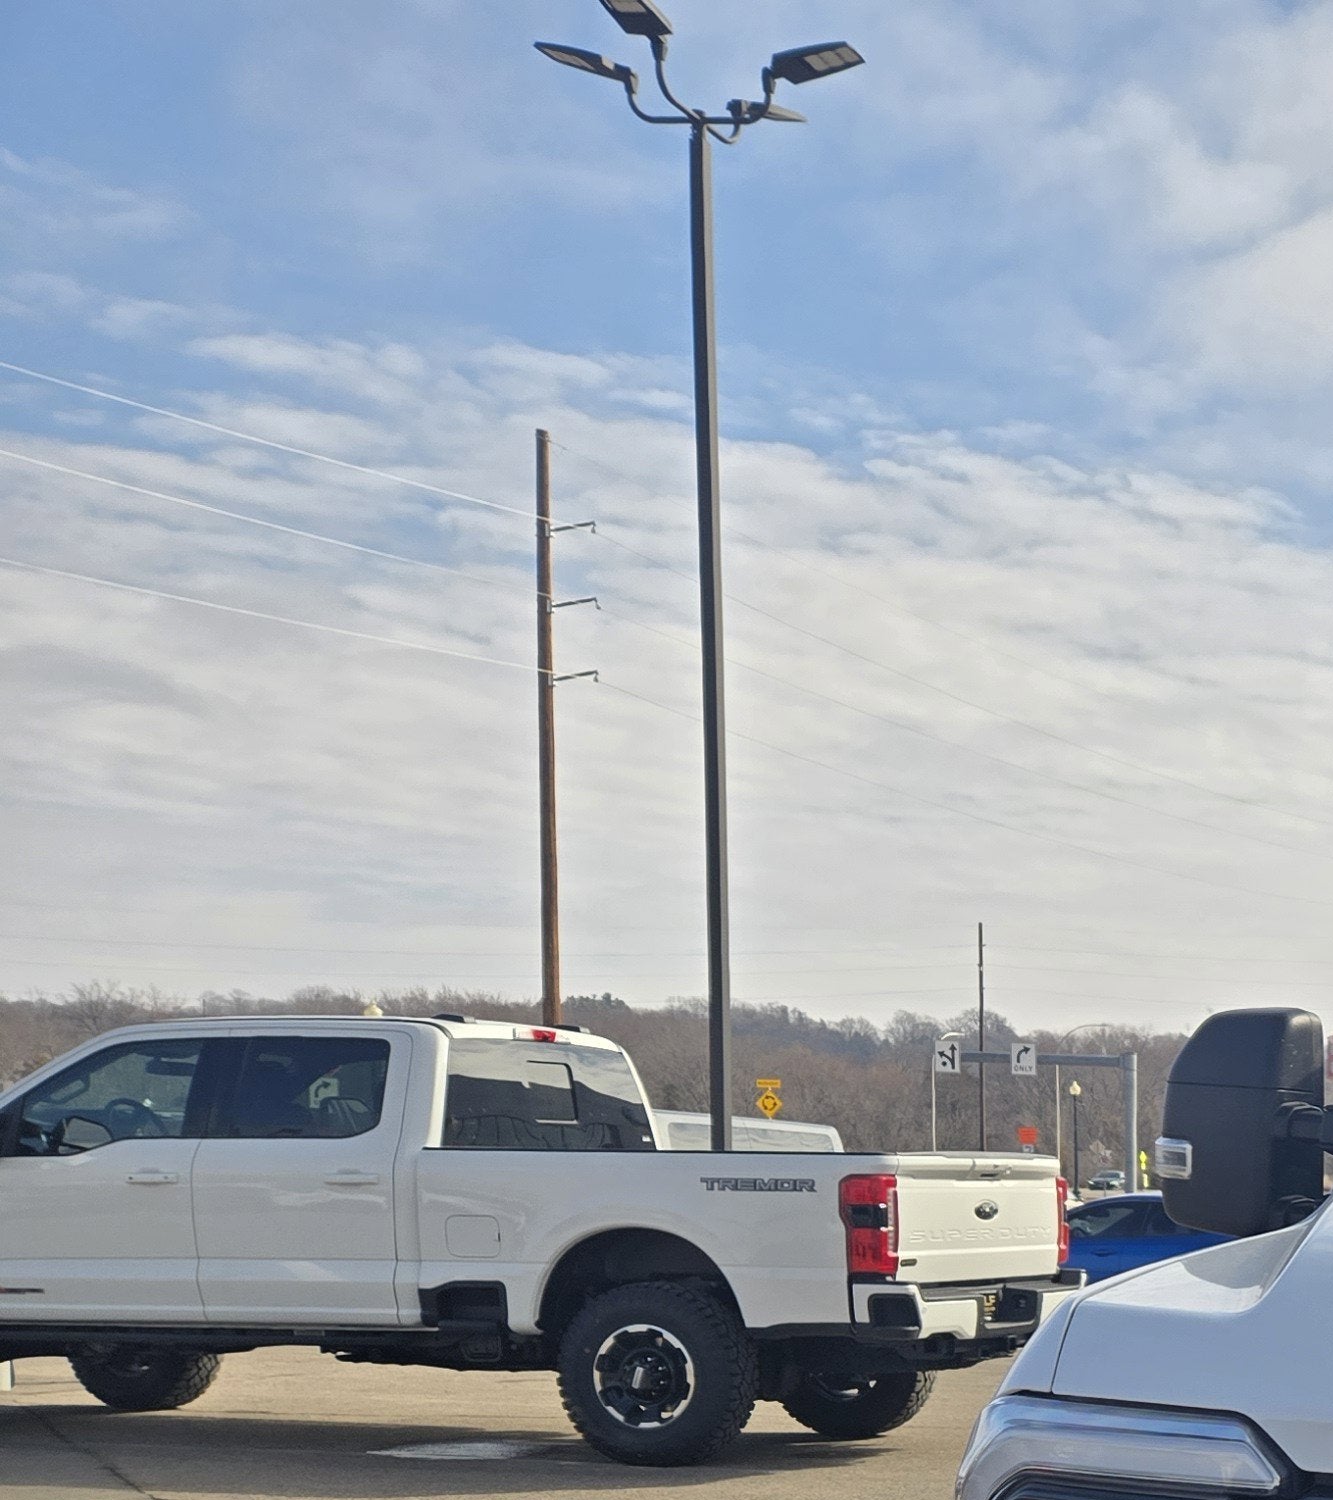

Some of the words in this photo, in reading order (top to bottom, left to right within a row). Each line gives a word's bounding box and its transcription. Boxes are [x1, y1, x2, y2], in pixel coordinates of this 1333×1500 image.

[700, 1177, 817, 1193] TREMOR
[909, 1228, 995, 1243] SUPER
[1000, 1226, 1052, 1240] DUTY
